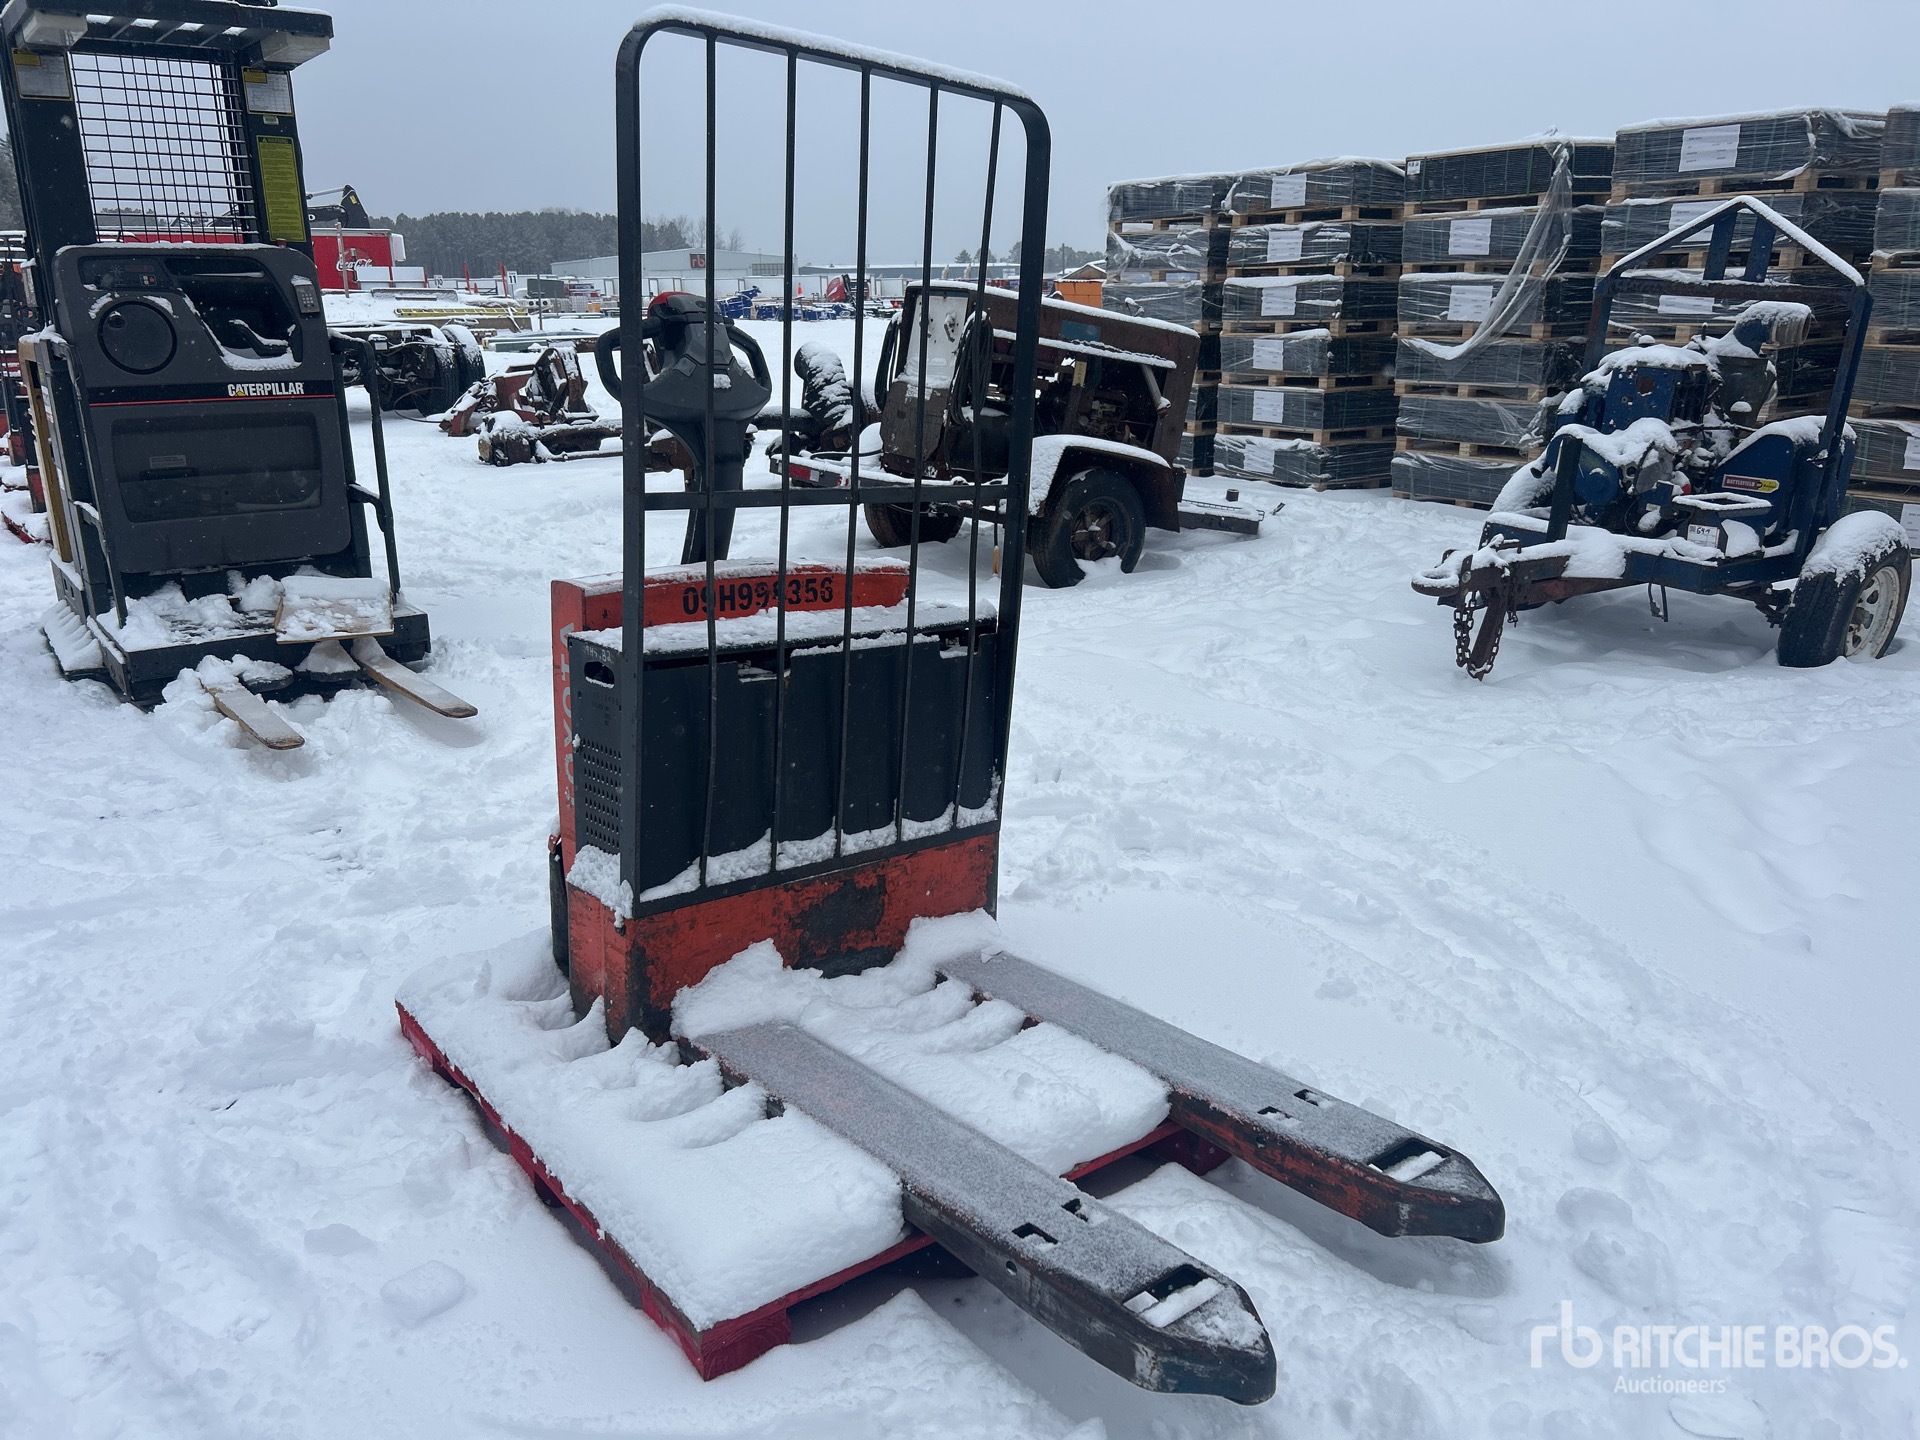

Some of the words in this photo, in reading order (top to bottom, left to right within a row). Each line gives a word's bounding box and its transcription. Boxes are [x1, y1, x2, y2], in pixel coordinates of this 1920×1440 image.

[692, 255, 705, 267] rb
[508, 275, 517, 284] 11
[227, 382, 304, 397] CATERPILLAR
[682, 577, 834, 615] 09H99356
